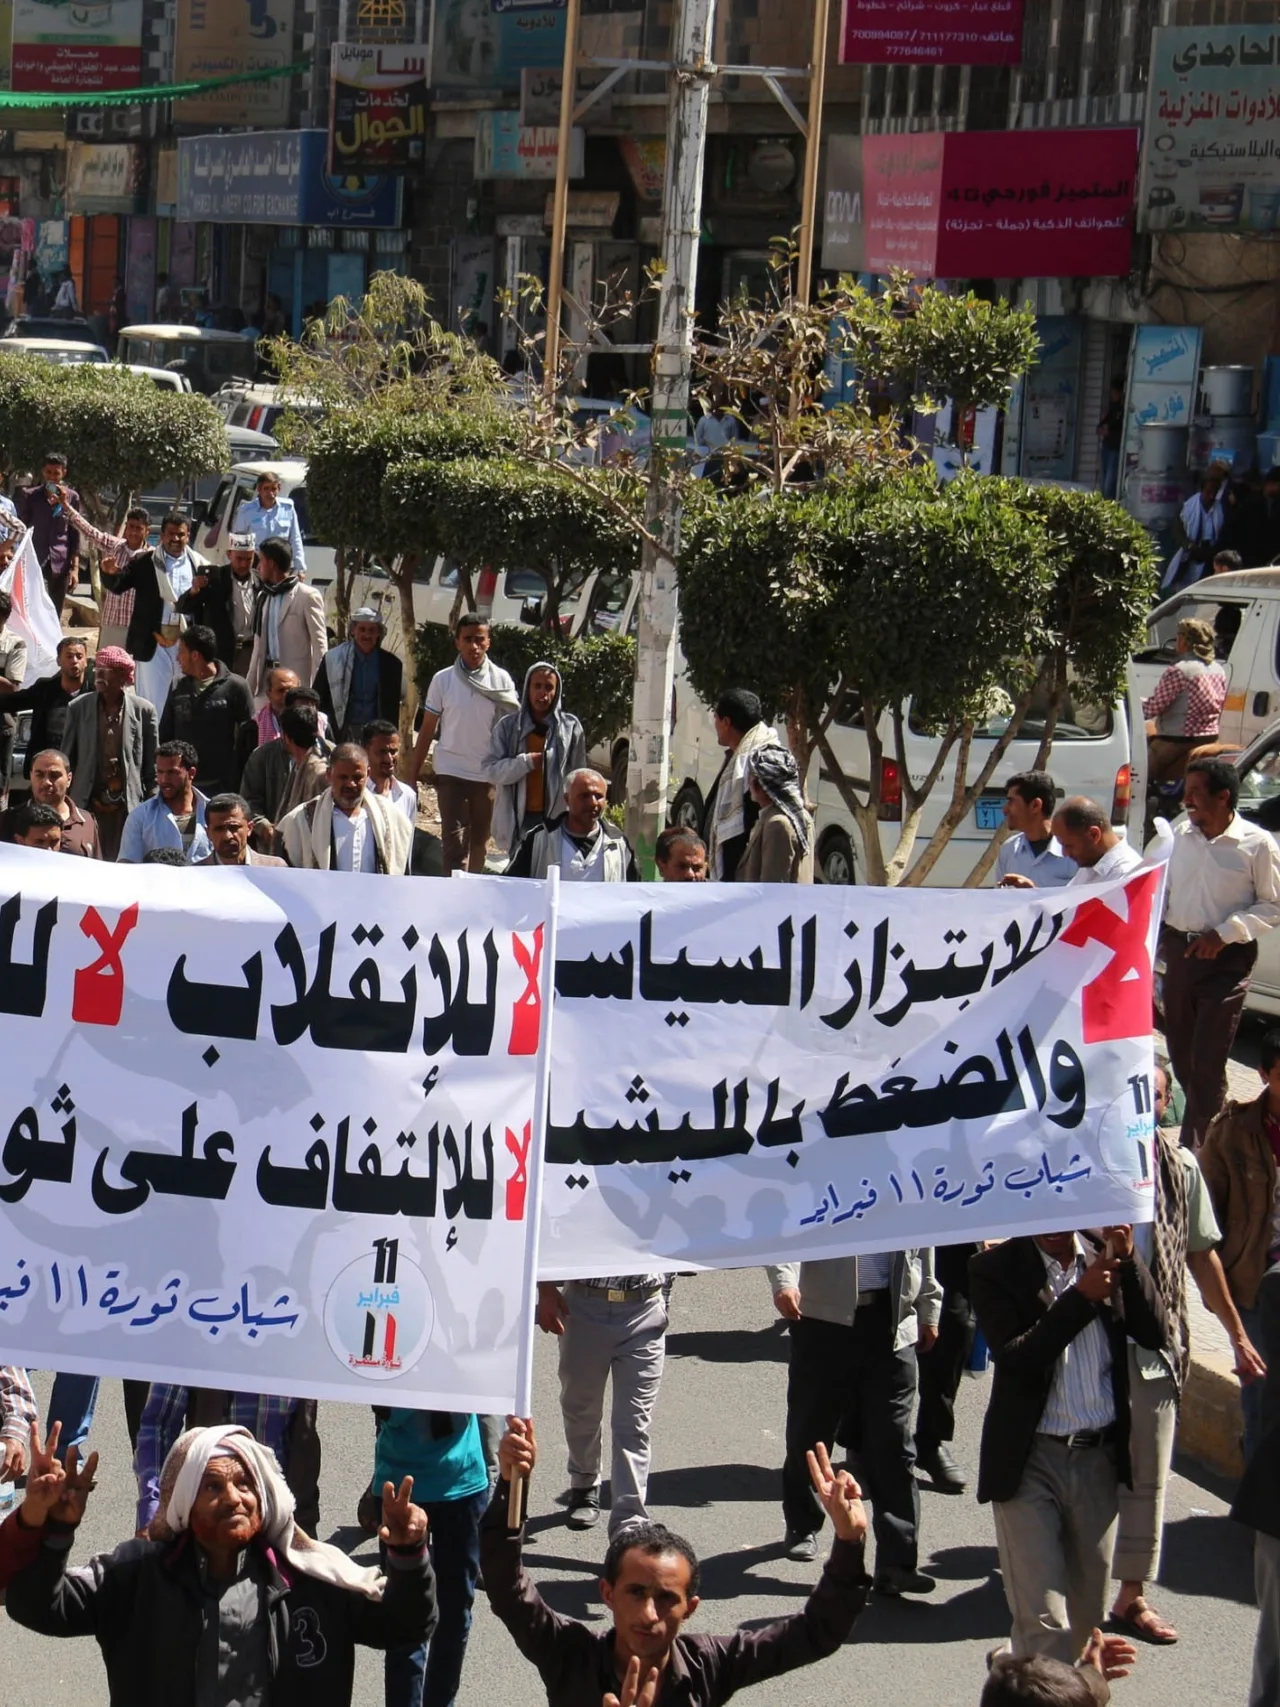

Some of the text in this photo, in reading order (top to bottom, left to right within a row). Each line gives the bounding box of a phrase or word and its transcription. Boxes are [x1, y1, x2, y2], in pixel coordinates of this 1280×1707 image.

[340, 46, 374, 61] موبايل
[355, 91, 410, 107] لخدمات
[1158, 90, 1220, 127] المنزلية
[334, 103, 425, 156] الجوال
[1190, 138, 1280, 162] والبلاستيكية
[1032, 217, 1073, 232] الذكية
[70, 901, 139, 1027] لا
[506, 921, 546, 1056] لا
[553, 909, 819, 1028] السياس
[166, 920, 500, 1098] للإنقلاب
[816, 1024, 1088, 1141] والضغط
[91, 1100, 238, 1215] على
[256, 1111, 495, 1252] للإلتفاف
[504, 1118, 533, 1221] لا
[1005, 1151, 1093, 1202] شباب
[799, 1180, 878, 1228] فبراير
[933, 1161, 996, 1210] ثورة
[372, 1237, 400, 1285] 11
[97, 1270, 182, 1327] ثورة
[188, 1281, 300, 1339] شباب
[355, 1285, 401, 1310] فبراير
[294, 1606, 327, 1668] 3
